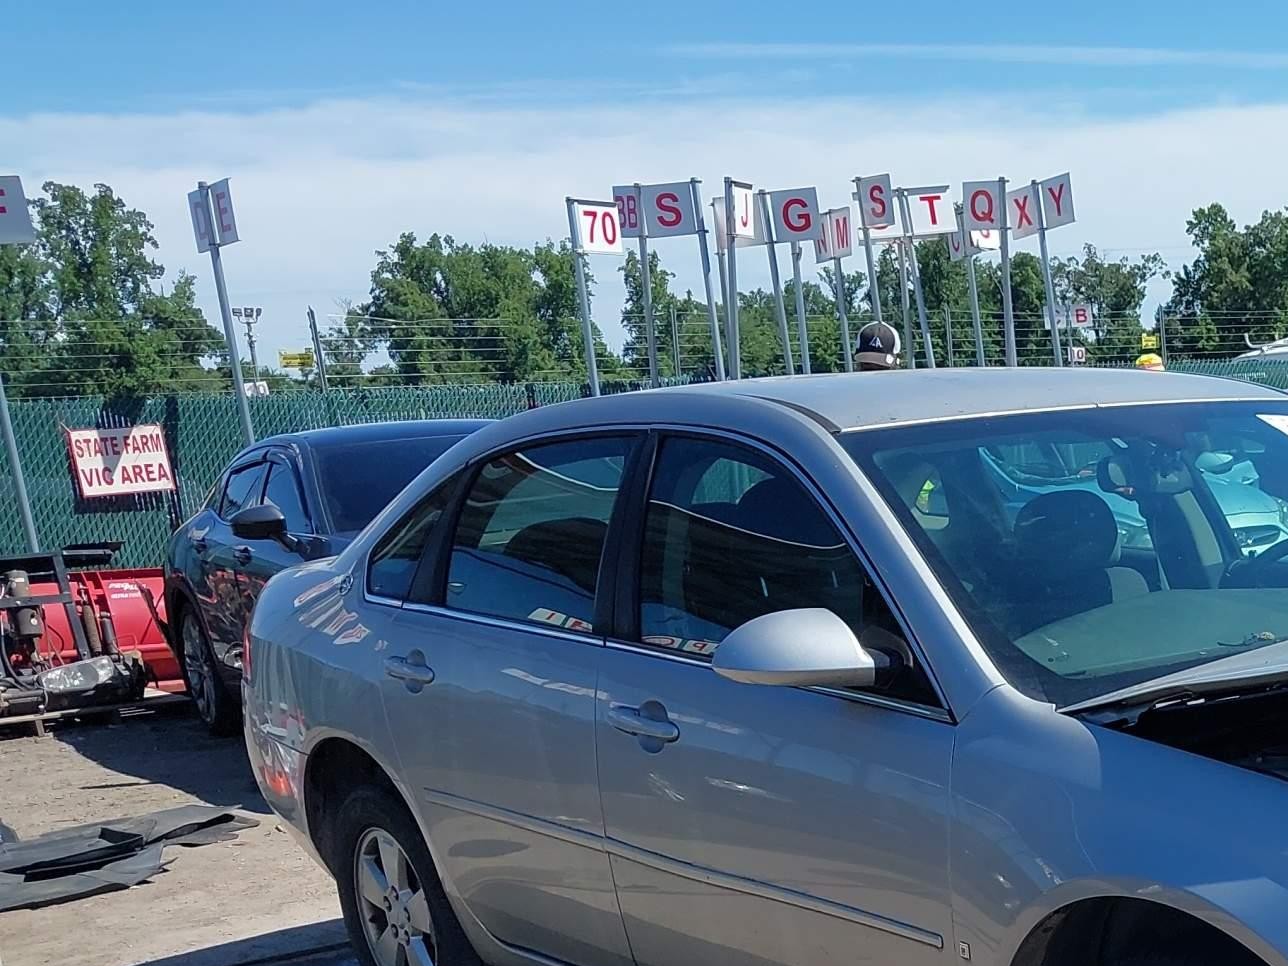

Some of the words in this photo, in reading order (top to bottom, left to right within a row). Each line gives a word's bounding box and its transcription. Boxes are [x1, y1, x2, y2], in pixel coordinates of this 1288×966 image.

[216, 192, 231, 232] E
[656, 192, 682, 227] S
[740, 194, 748, 228] J
[782, 198, 811, 232] G
[869, 185, 886, 218] S
[919, 195, 942, 225] T
[970, 190, 995, 223] Q
[1014, 195, 1033, 229] X
[1048, 183, 1064, 217] Y
[583, 210, 618, 245] 70
[835, 216, 848, 249] M
[1075, 308, 1088, 324] B
[75, 436, 120, 458] STATE
[124, 433, 163, 455] FARM
[81, 466, 114, 488] VIC
[121, 463, 170, 485] AREA
